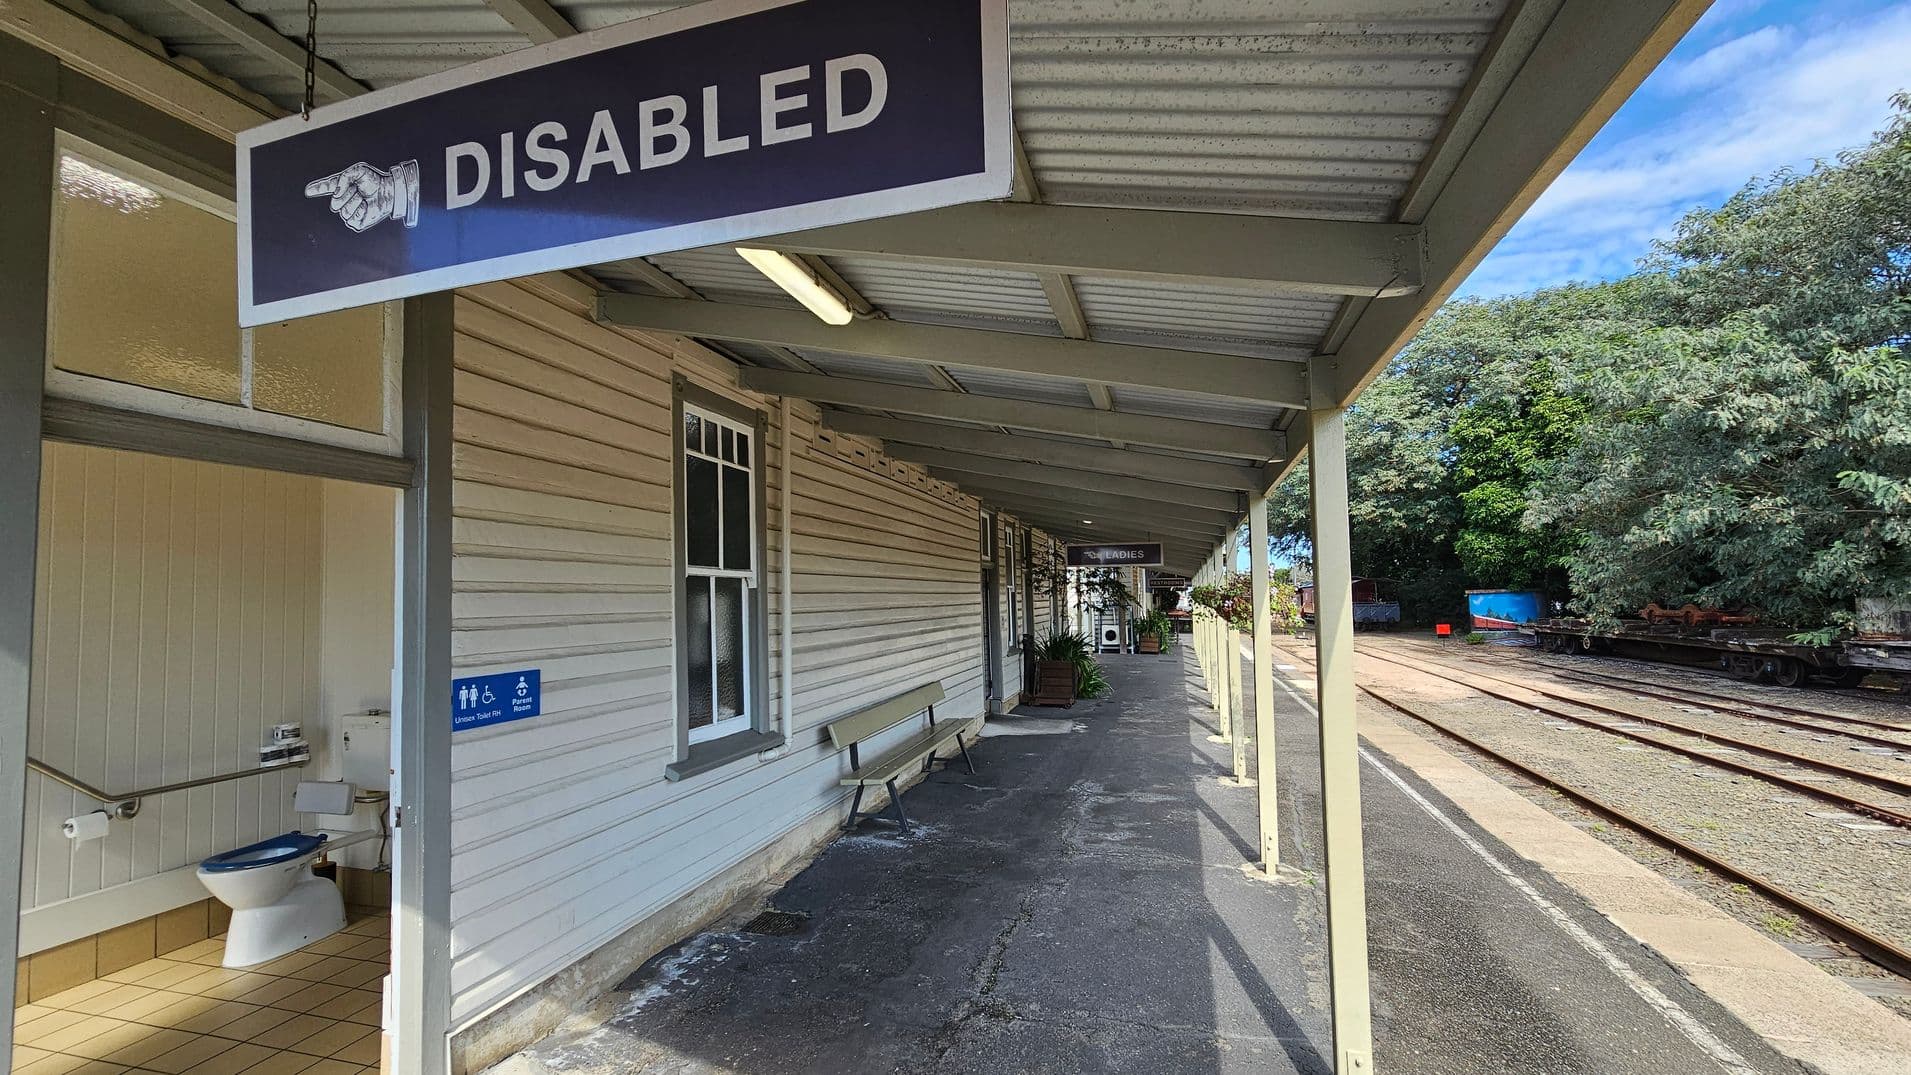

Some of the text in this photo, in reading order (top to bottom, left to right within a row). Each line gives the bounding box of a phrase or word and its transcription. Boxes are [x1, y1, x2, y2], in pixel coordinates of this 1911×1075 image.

[445, 53, 888, 211] DISABLED
[1106, 550, 1145, 559] LADIES
[512, 697, 533, 705] Parent
[513, 705, 532, 713] Room
[455, 716, 476, 724] Unisex
[476, 712, 491, 720] Toilet
